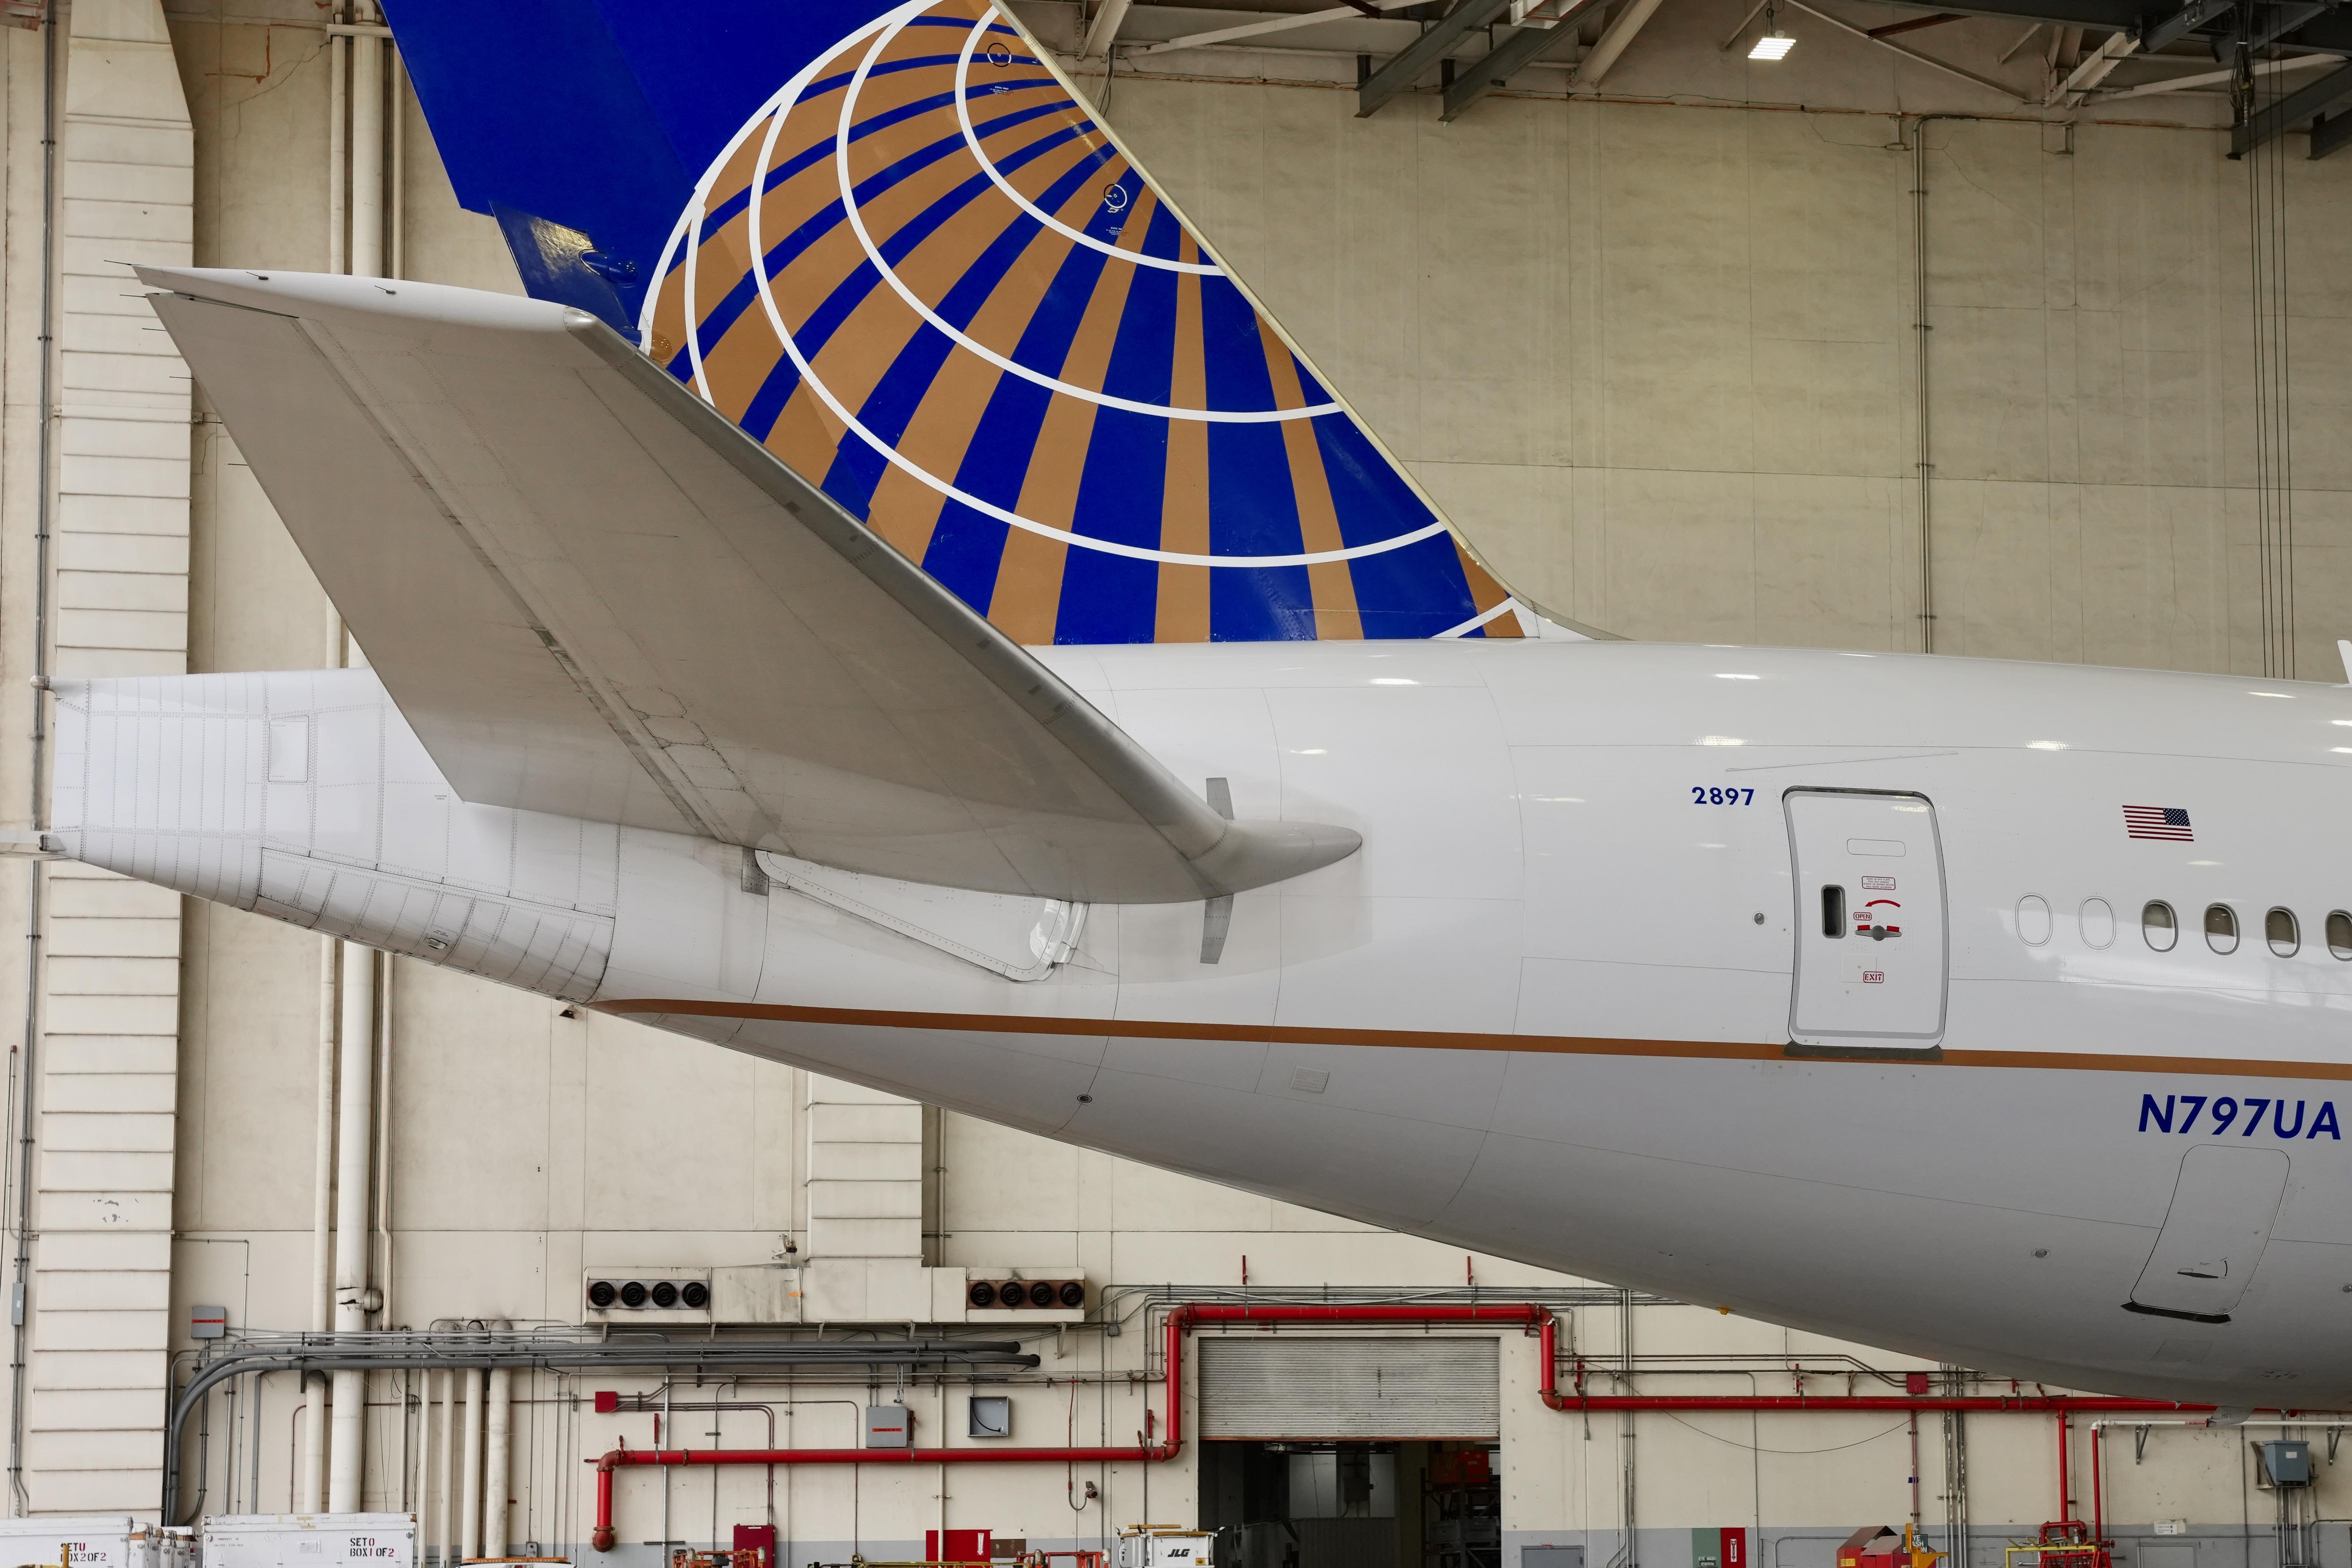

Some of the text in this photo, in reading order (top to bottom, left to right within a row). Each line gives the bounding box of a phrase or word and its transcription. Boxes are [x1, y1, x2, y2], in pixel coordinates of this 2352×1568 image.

[1692, 786, 1754, 805] 2897
[2138, 1094, 2341, 1140] N797UA
[1167, 1549, 1190, 1557] JLG
